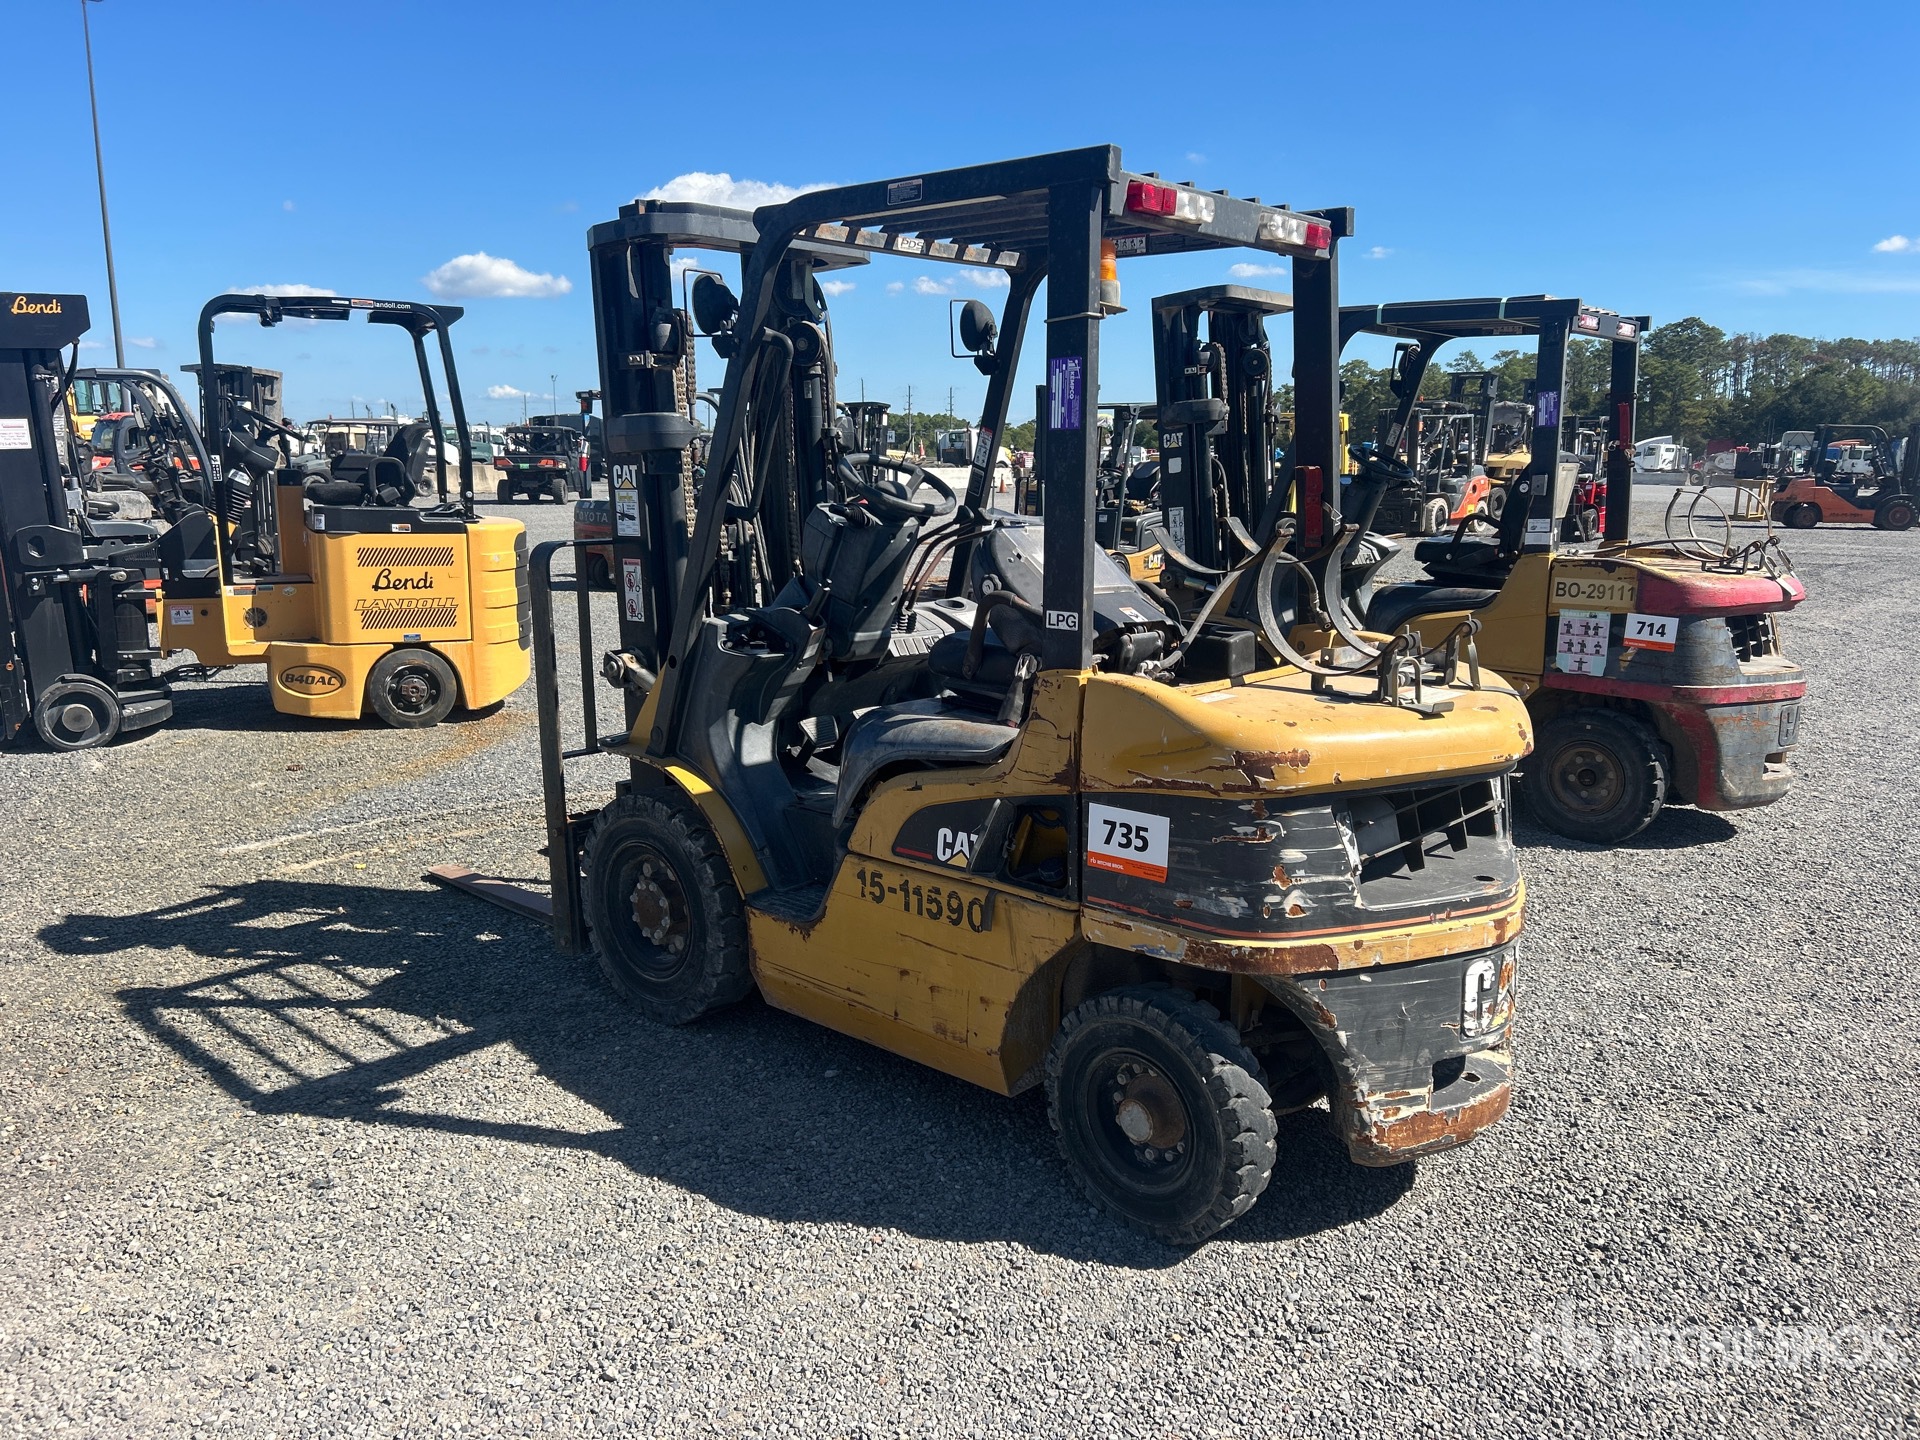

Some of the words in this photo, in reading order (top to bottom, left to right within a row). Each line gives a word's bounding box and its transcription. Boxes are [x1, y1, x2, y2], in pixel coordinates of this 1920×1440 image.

[11, 296, 62, 314] Bendi
[374, 301, 411, 309] landoll.com
[1163, 432, 1183, 448] CAT
[613, 465, 637, 488] CAT
[576, 510, 609, 523] TOYOTA
[1149, 553, 1162, 569] CAT
[372, 568, 434, 591] Bendi
[1555, 581, 1635, 601] BO-29111
[354, 597, 459, 611] LANDOLL
[1048, 612, 1077, 628] LPG
[1636, 621, 1666, 637] 714
[1103, 819, 1149, 853] 735
[857, 867, 984, 933] 15-11590
